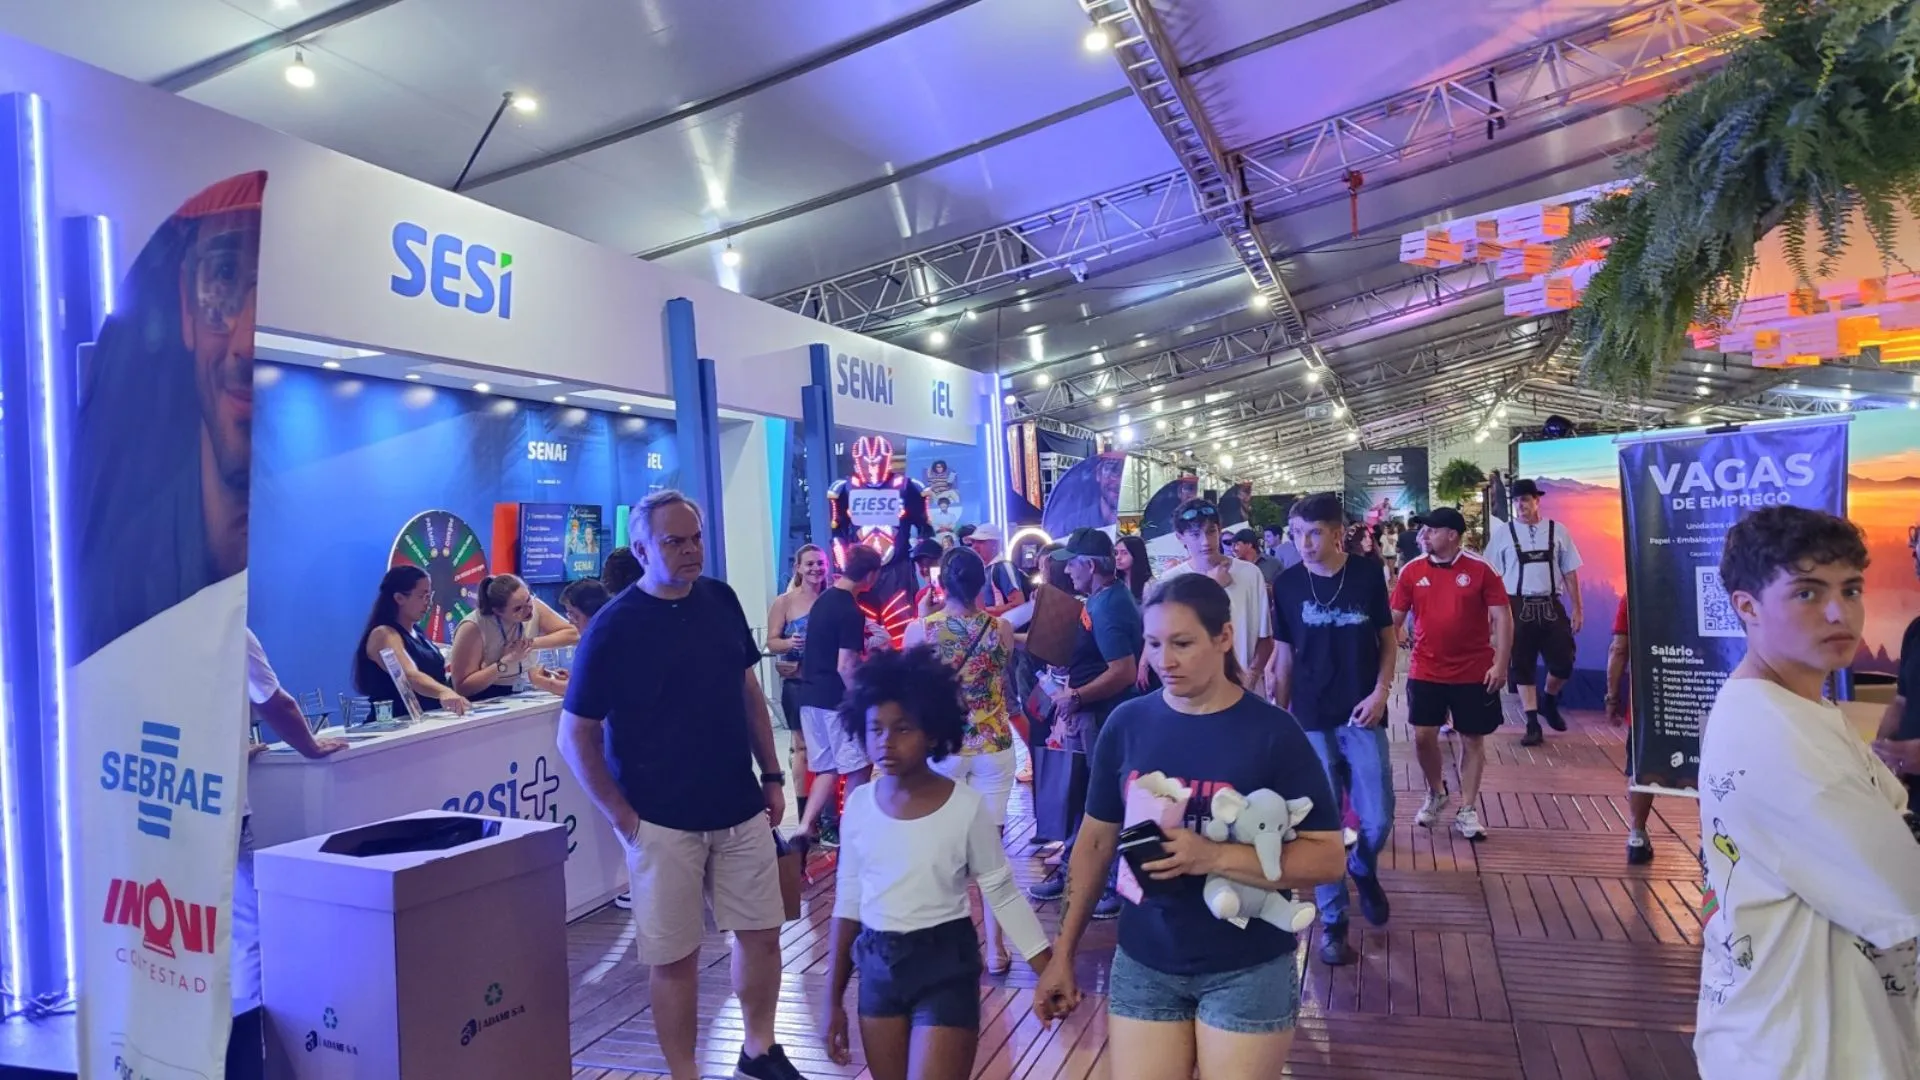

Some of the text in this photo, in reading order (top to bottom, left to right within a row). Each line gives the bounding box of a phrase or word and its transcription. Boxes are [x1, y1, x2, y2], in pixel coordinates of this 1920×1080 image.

[1648, 453, 1816, 495] VAGAS
[1672, 491, 1791, 511] DE EMPREGO
[1649, 536, 1671, 545] Papel
[1650, 644, 1694, 657] Salário
[1661, 655, 1705, 665] Benefícios
[1663, 691, 1697, 699] Academia
[100, 751, 223, 815] SEBRAE
